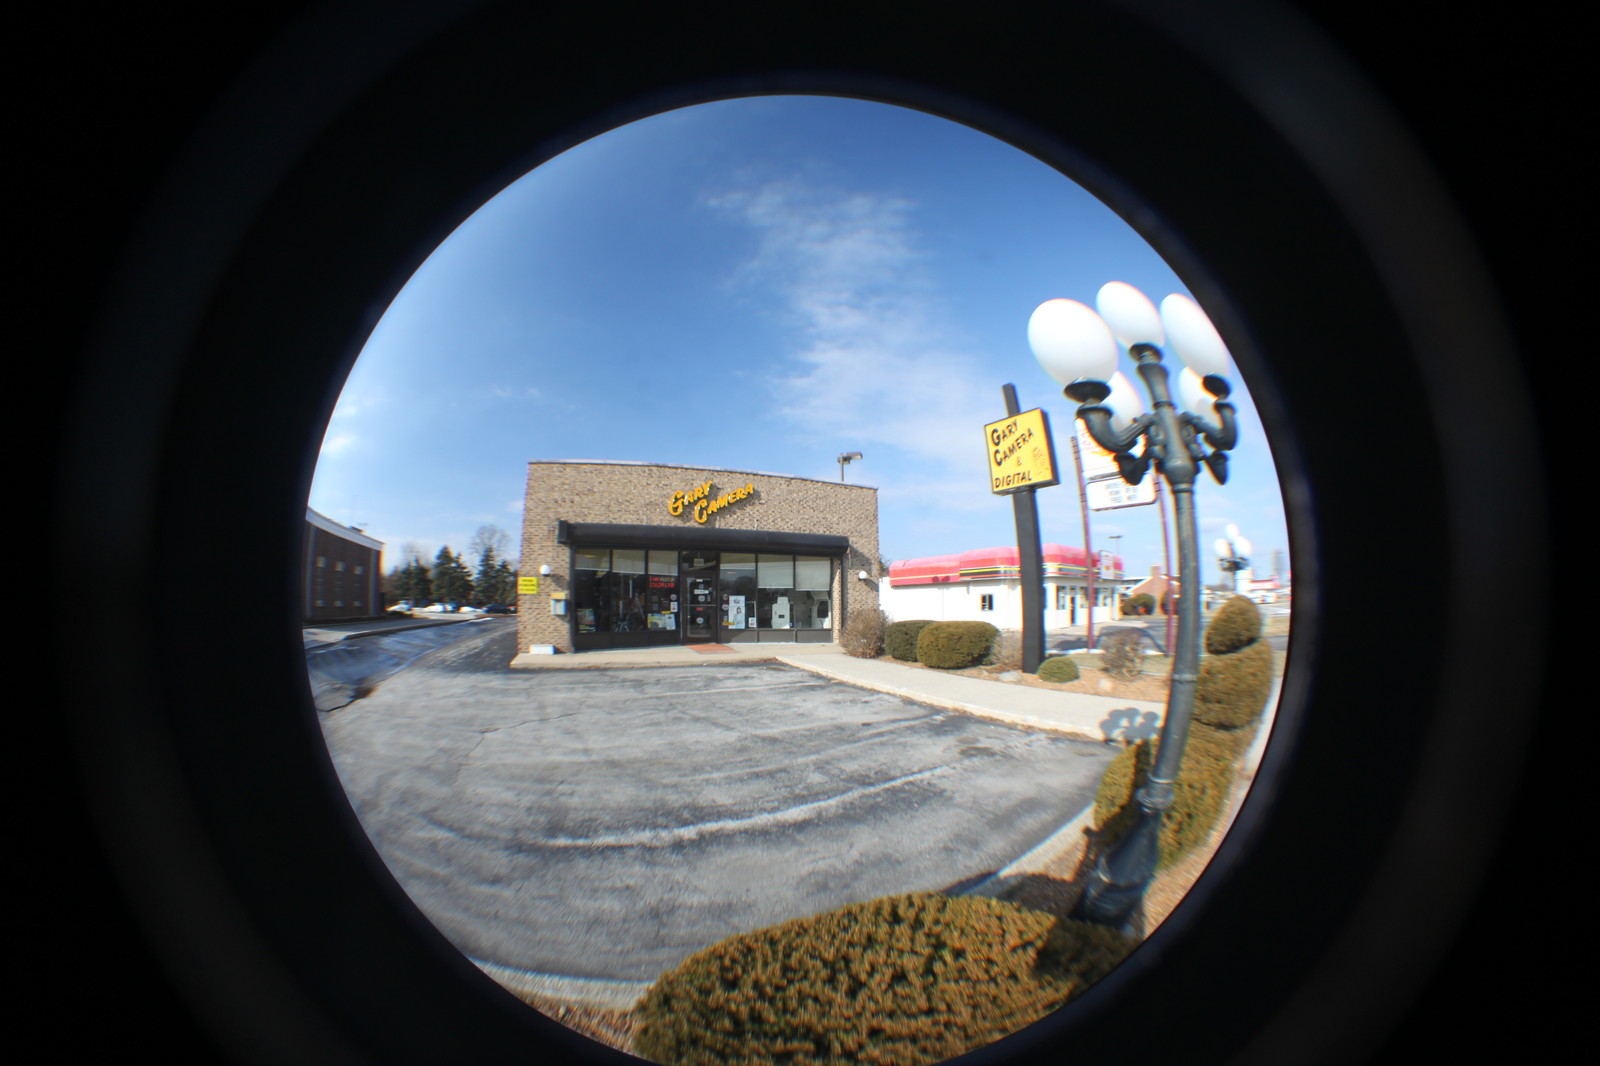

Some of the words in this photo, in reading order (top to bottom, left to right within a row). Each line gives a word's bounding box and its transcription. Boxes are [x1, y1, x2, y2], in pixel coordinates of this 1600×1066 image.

[991, 419, 1018, 447] GARY
[994, 428, 1034, 467] CAMERA
[1016, 456, 1022, 467] &
[995, 470, 1032, 488] DIGITAL
[668, 480, 712, 515] GARY
[694, 483, 754, 523] CAMERA
